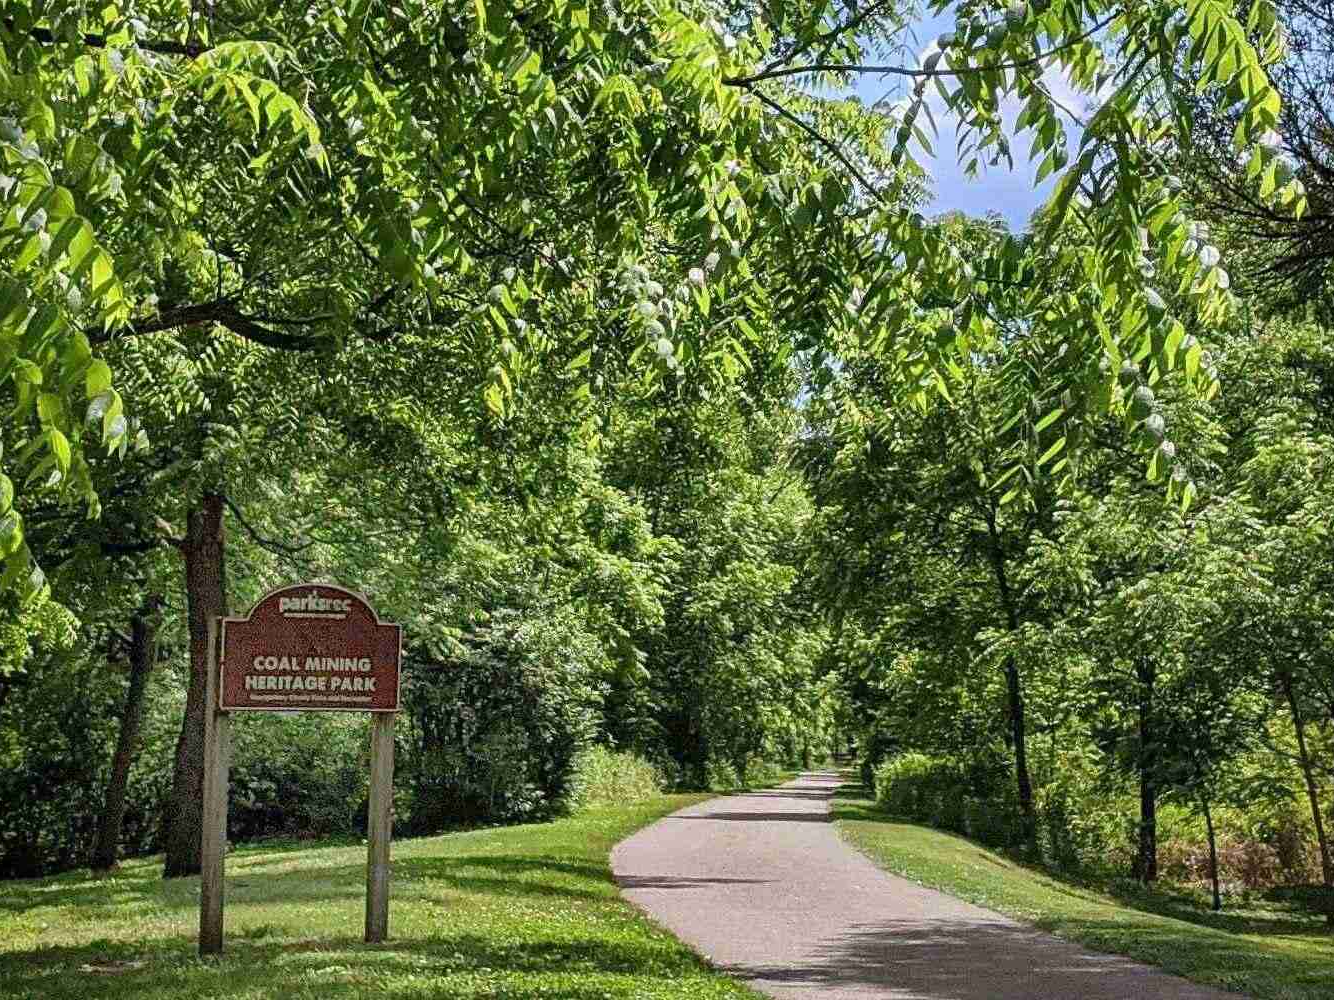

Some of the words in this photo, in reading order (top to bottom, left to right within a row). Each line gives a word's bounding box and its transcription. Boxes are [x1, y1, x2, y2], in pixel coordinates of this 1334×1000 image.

[253, 656, 300, 671] COAL
[305, 656, 371, 672] MINING
[245, 675, 327, 690] HERITAGE
[330, 677, 377, 691] PARK
